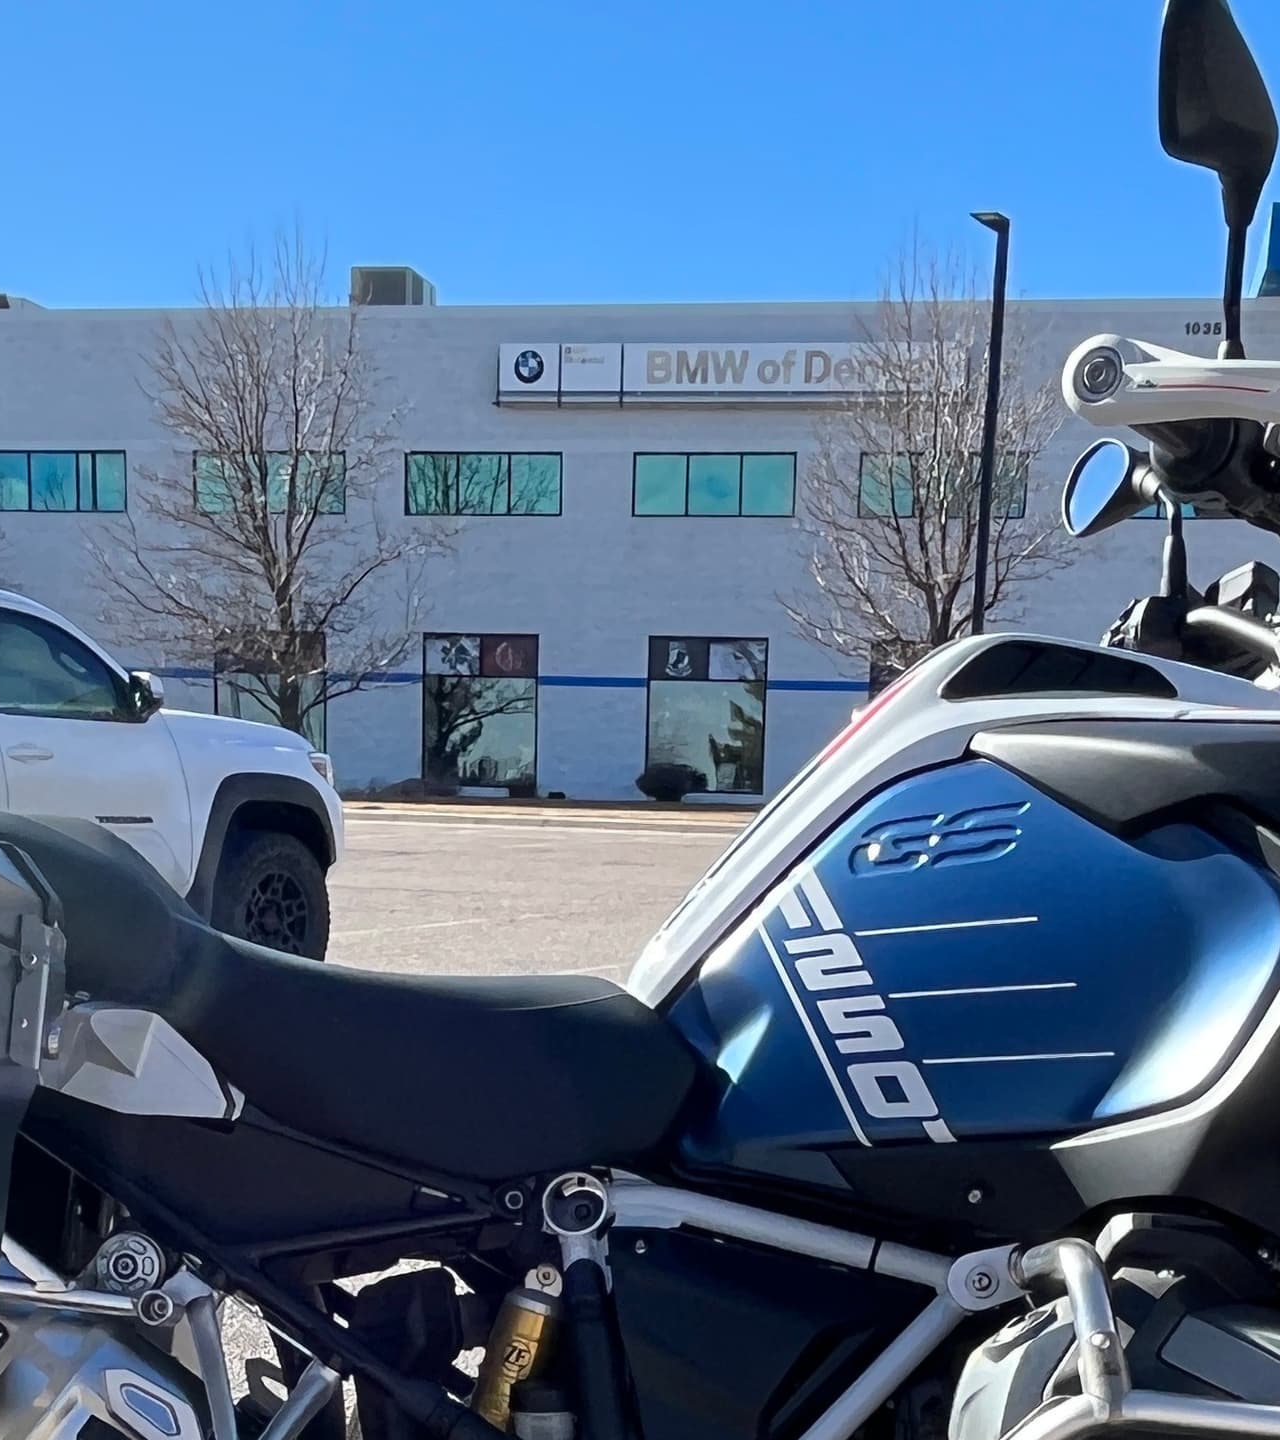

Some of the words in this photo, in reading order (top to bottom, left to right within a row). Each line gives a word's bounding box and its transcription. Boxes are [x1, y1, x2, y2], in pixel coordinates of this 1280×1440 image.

[646, 350, 750, 384] BMW
[756, 350, 797, 384] of
[803, 350, 941, 386] Den
[848, 800, 1032, 878] GS
